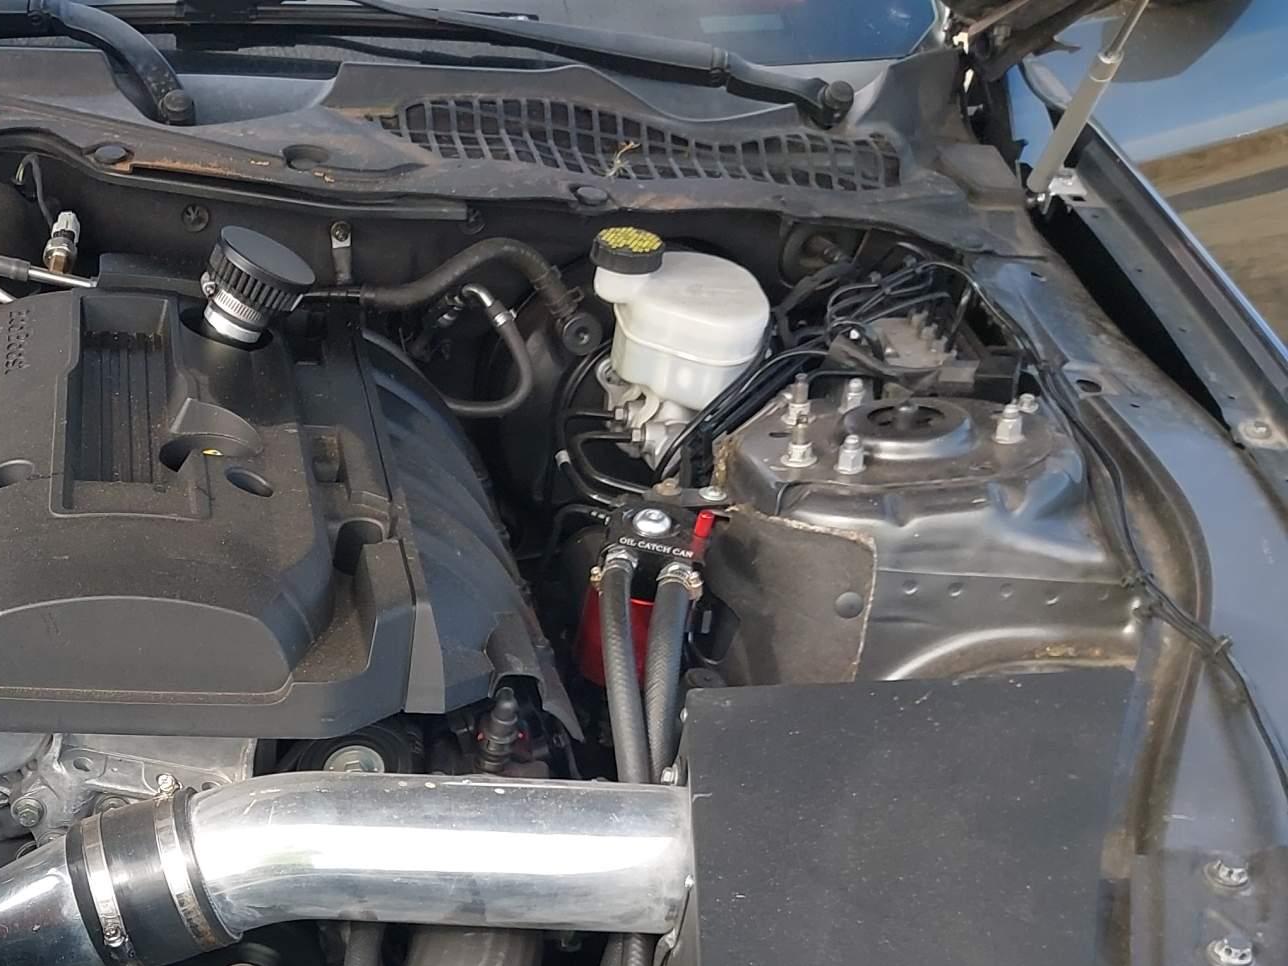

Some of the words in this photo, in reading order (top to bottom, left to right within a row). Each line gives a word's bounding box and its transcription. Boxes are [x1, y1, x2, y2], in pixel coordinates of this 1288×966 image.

[619, 536, 637, 547] OIL
[637, 541, 671, 554] CATCH
[672, 548, 694, 558] CAN
